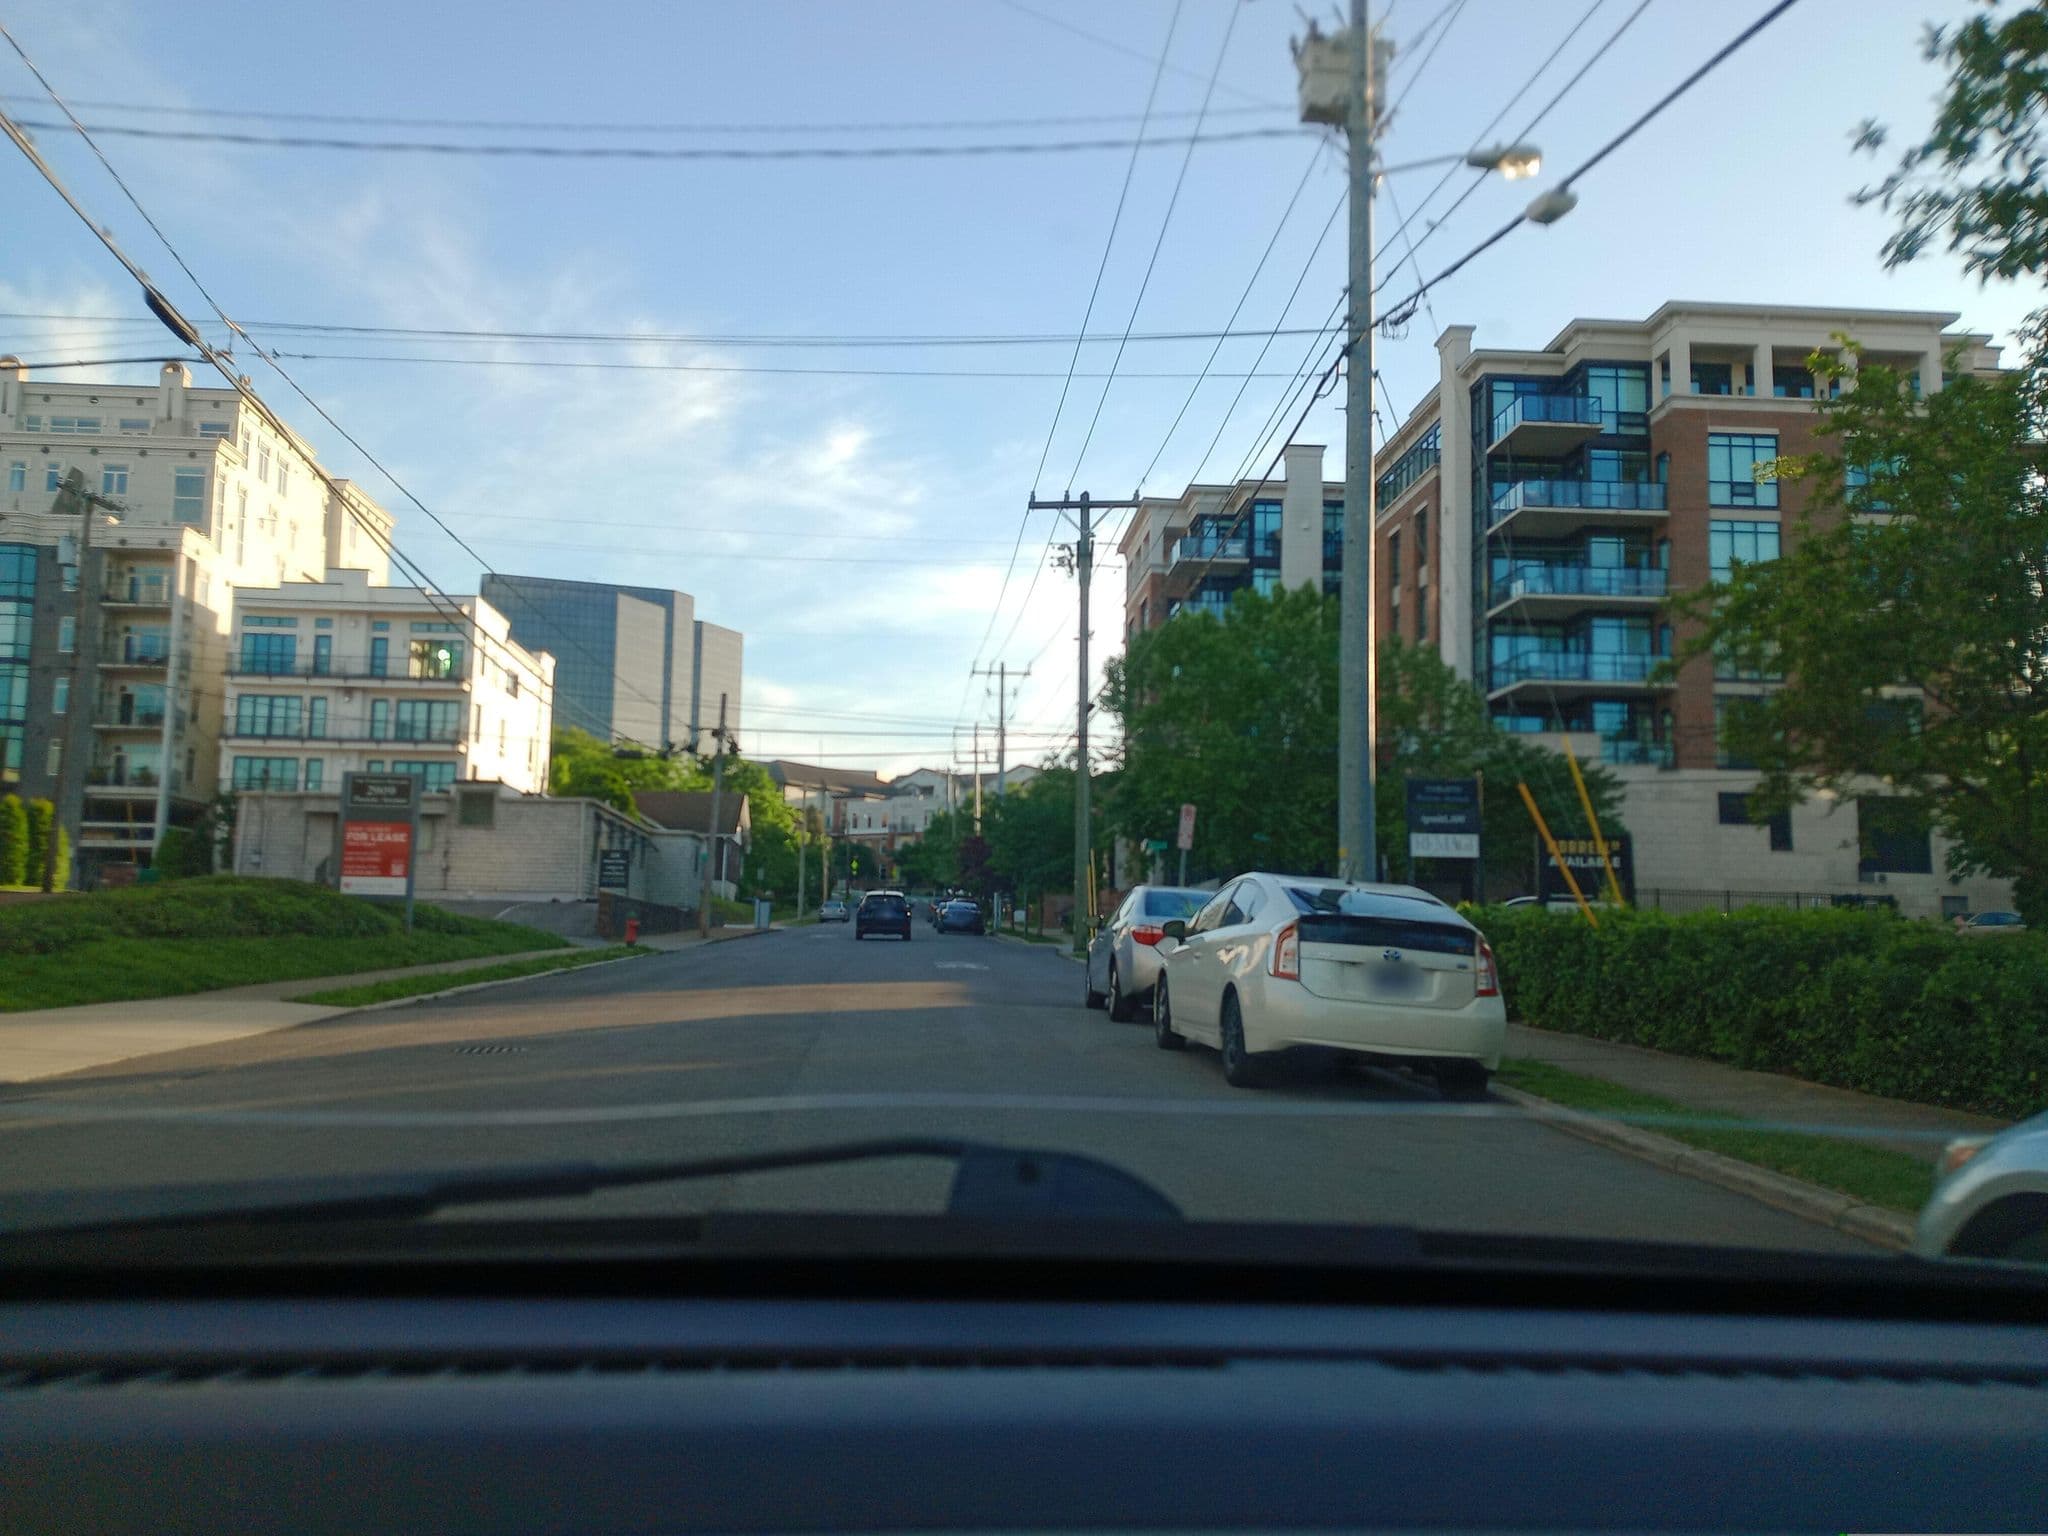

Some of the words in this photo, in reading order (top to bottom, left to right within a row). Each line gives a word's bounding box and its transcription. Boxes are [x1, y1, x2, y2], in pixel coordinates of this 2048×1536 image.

[345, 831, 369, 841] FOR
[370, 832, 409, 843] LEASE
[1548, 855, 1621, 868] AAILABE
